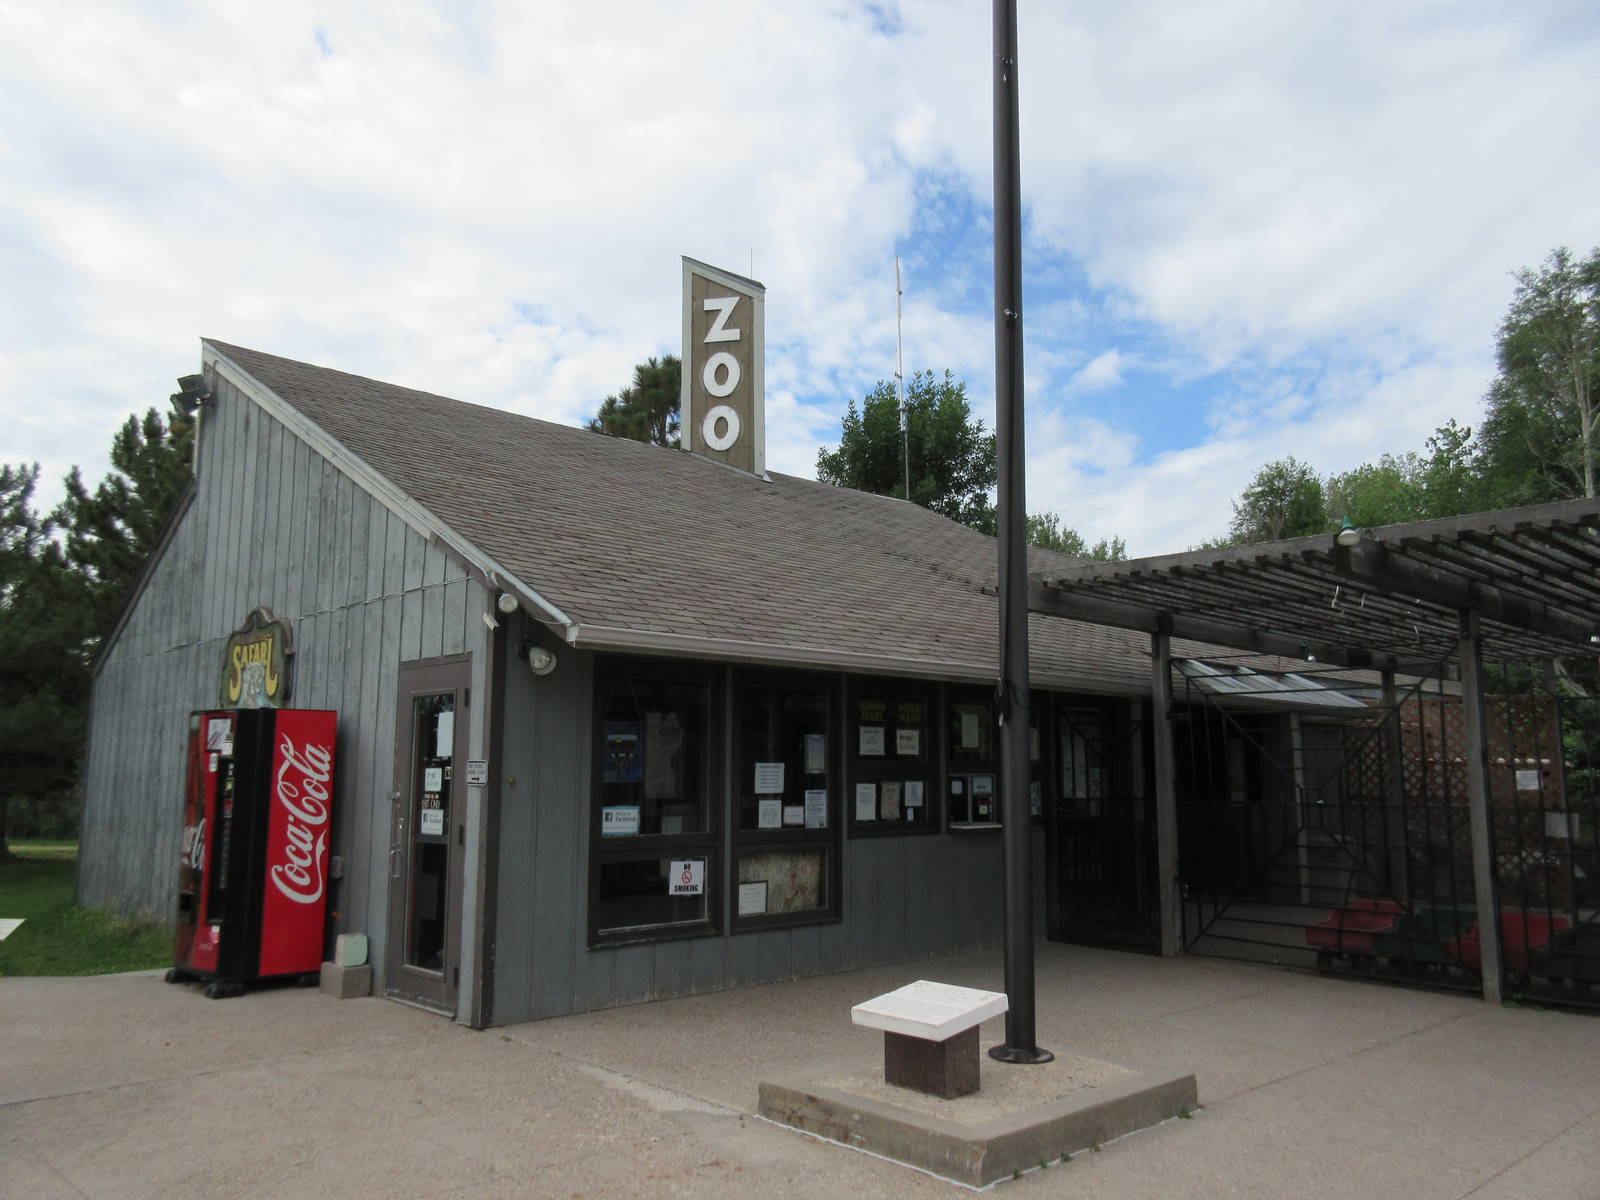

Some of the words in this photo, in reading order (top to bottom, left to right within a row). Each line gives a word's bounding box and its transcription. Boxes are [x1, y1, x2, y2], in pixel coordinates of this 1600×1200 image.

[702, 296, 741, 452] ZOO
[229, 637, 278, 702] SAFARI
[683, 863, 691, 871] NO
[674, 884, 699, 893] SMOKING
